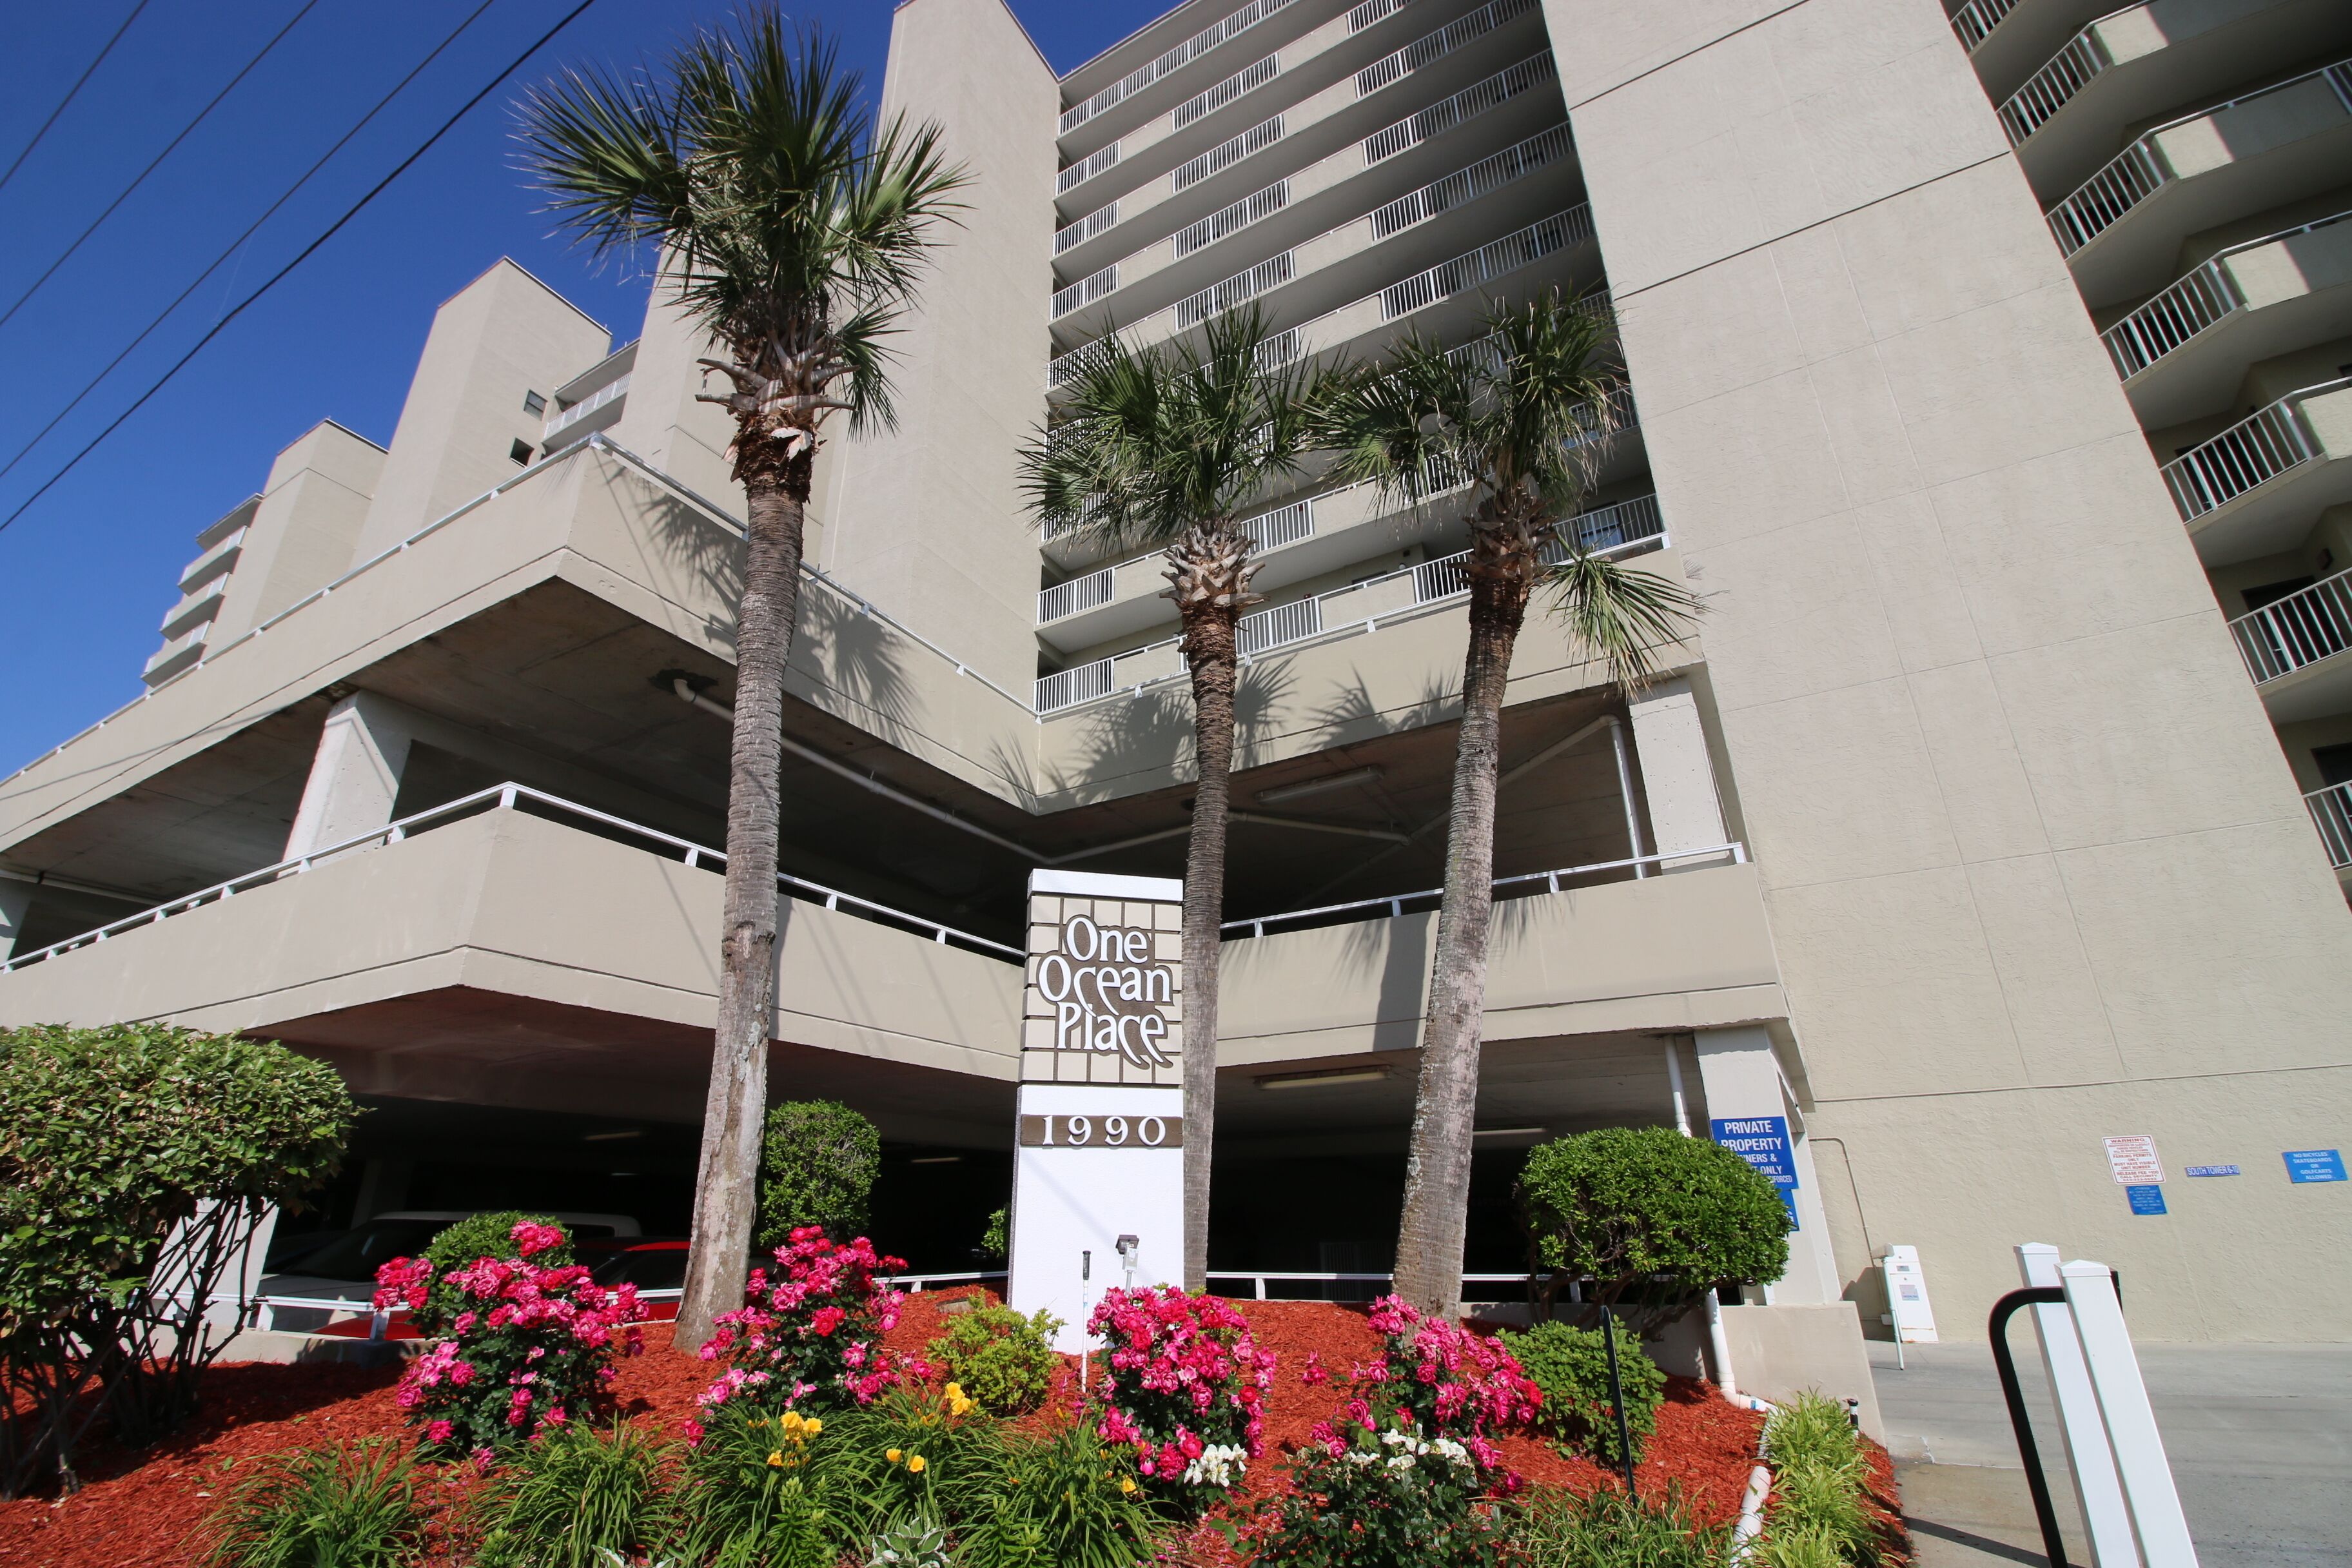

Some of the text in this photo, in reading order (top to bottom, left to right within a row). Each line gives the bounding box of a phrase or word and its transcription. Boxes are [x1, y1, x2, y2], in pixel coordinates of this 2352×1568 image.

[1066, 917, 1148, 964] One
[1039, 955, 1171, 1017] Ocean
[1057, 1001, 1165, 1064] Place
[1042, 1115, 1167, 1146] 1990
[1724, 1120, 1773, 1134] PRIVATE
[1720, 1137, 1781, 1152] PROPERTY
[1737, 1153, 1777, 1163] NERS &
[1760, 1166, 1782, 1175] ONLY
[2187, 1167, 2206, 1175] SOUTH
[2206, 1166, 2228, 1175] TOWER
